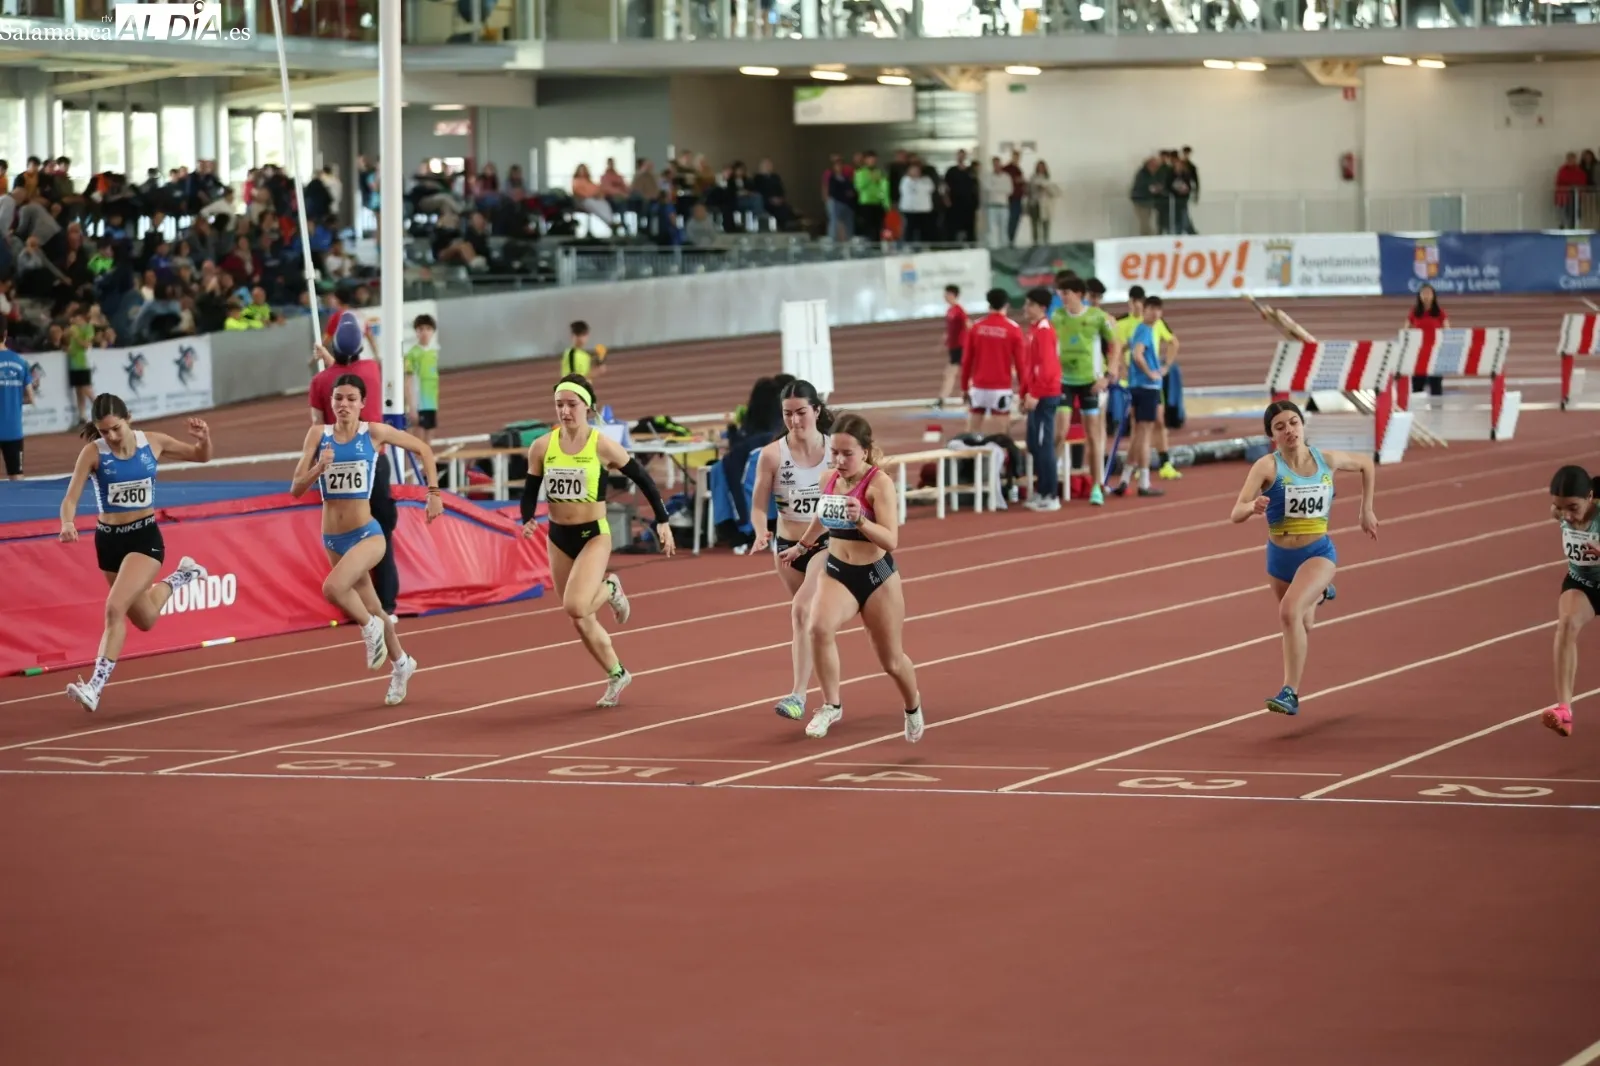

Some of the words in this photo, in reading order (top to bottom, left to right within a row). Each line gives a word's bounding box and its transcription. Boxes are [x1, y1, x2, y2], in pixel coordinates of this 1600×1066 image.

[1119, 240, 1251, 290] enjoy!
[329, 472, 362, 490] 2716
[549, 478, 581, 495] 2670
[112, 488, 146, 504] 2360
[1289, 496, 1324, 515] 2494
[115, 520, 143, 534] NIKE
[26, 755, 149, 767] 7
[276, 758, 397, 771] 6
[547, 764, 678, 778] 5
[819, 770, 942, 784] 4
[1117, 776, 1248, 790] 3
[1417, 783, 1555, 799] 2
